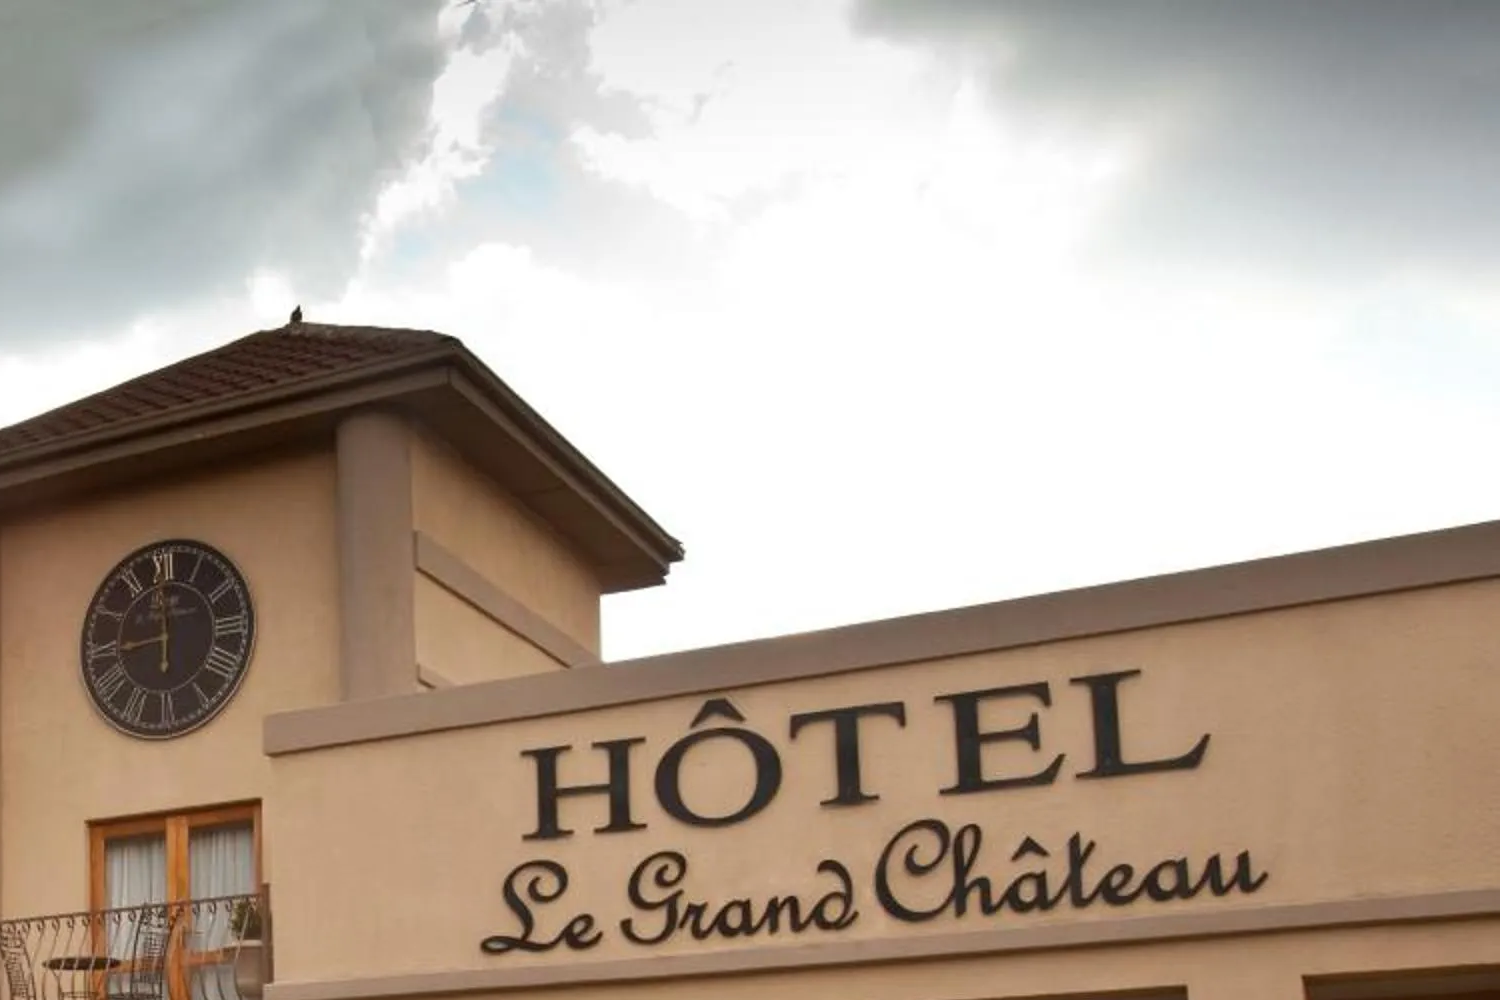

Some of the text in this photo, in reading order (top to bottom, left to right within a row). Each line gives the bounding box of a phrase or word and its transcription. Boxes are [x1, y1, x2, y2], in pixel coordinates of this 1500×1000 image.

[521, 668, 1210, 841] HÔTEL
[480, 818, 1268, 955] Le Grand Château
